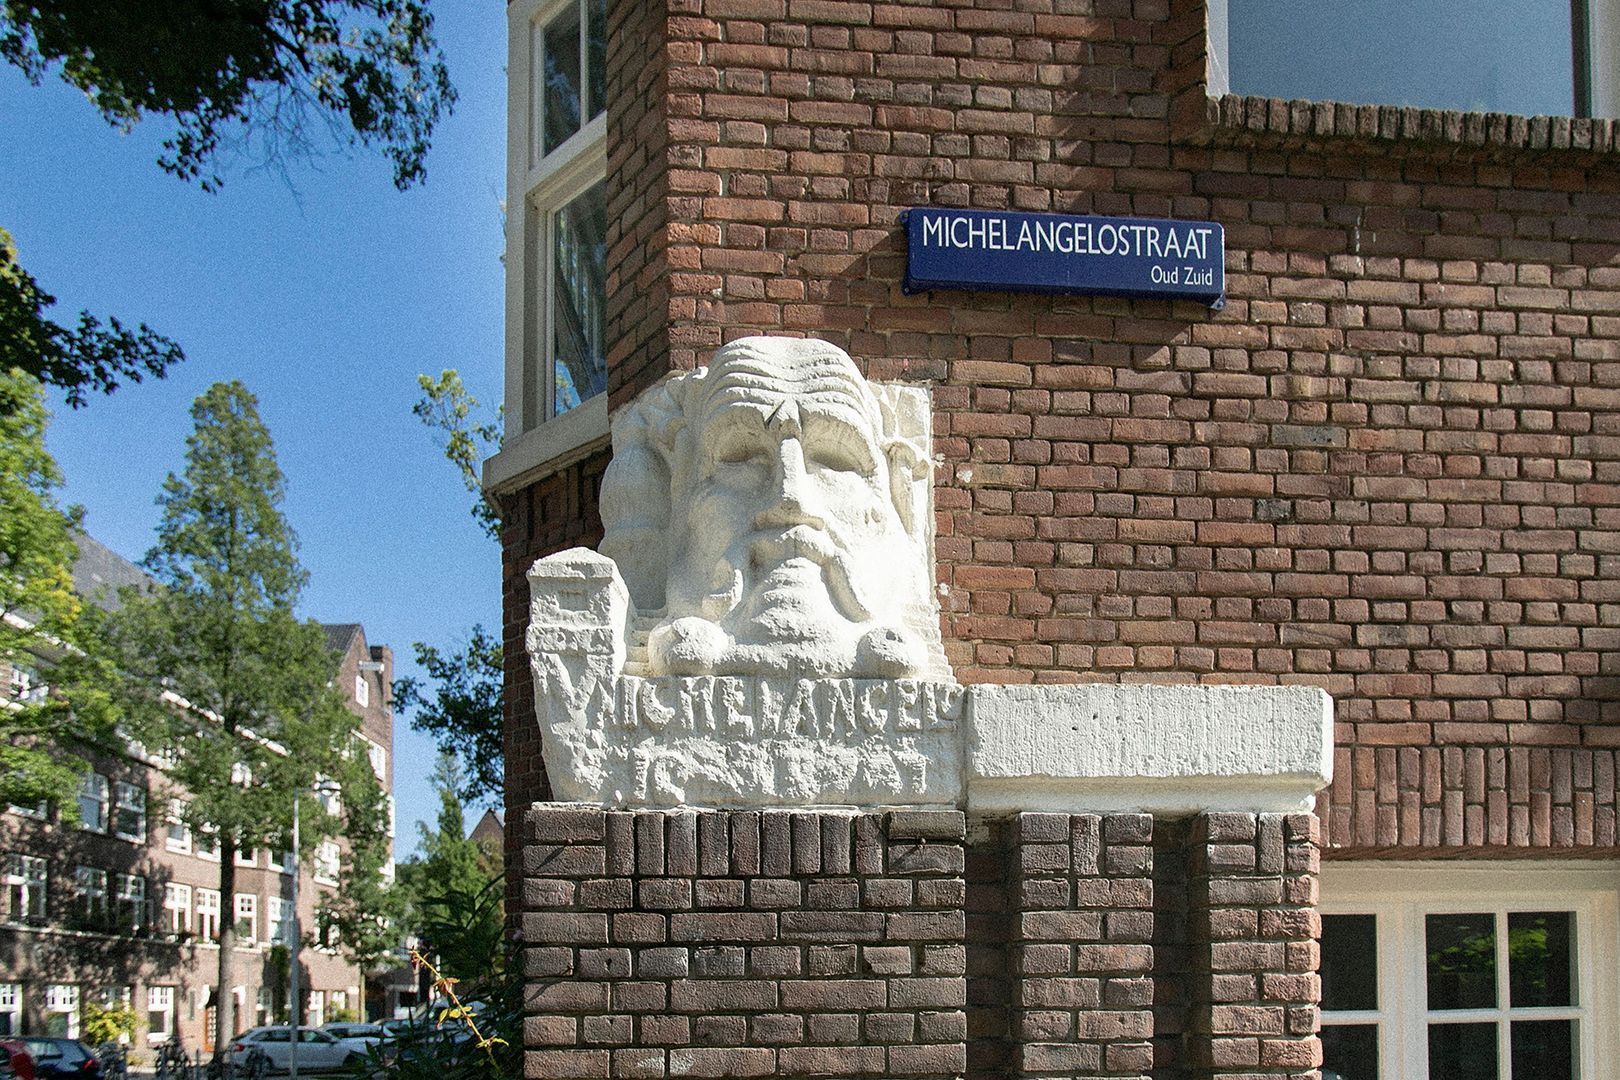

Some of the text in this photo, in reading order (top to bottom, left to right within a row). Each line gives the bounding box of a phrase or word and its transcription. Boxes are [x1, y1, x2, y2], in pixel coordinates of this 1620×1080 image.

[922, 215, 1212, 259] MICHELANGELOSTRAAT
[1150, 265, 1214, 287] Oud Zuid
